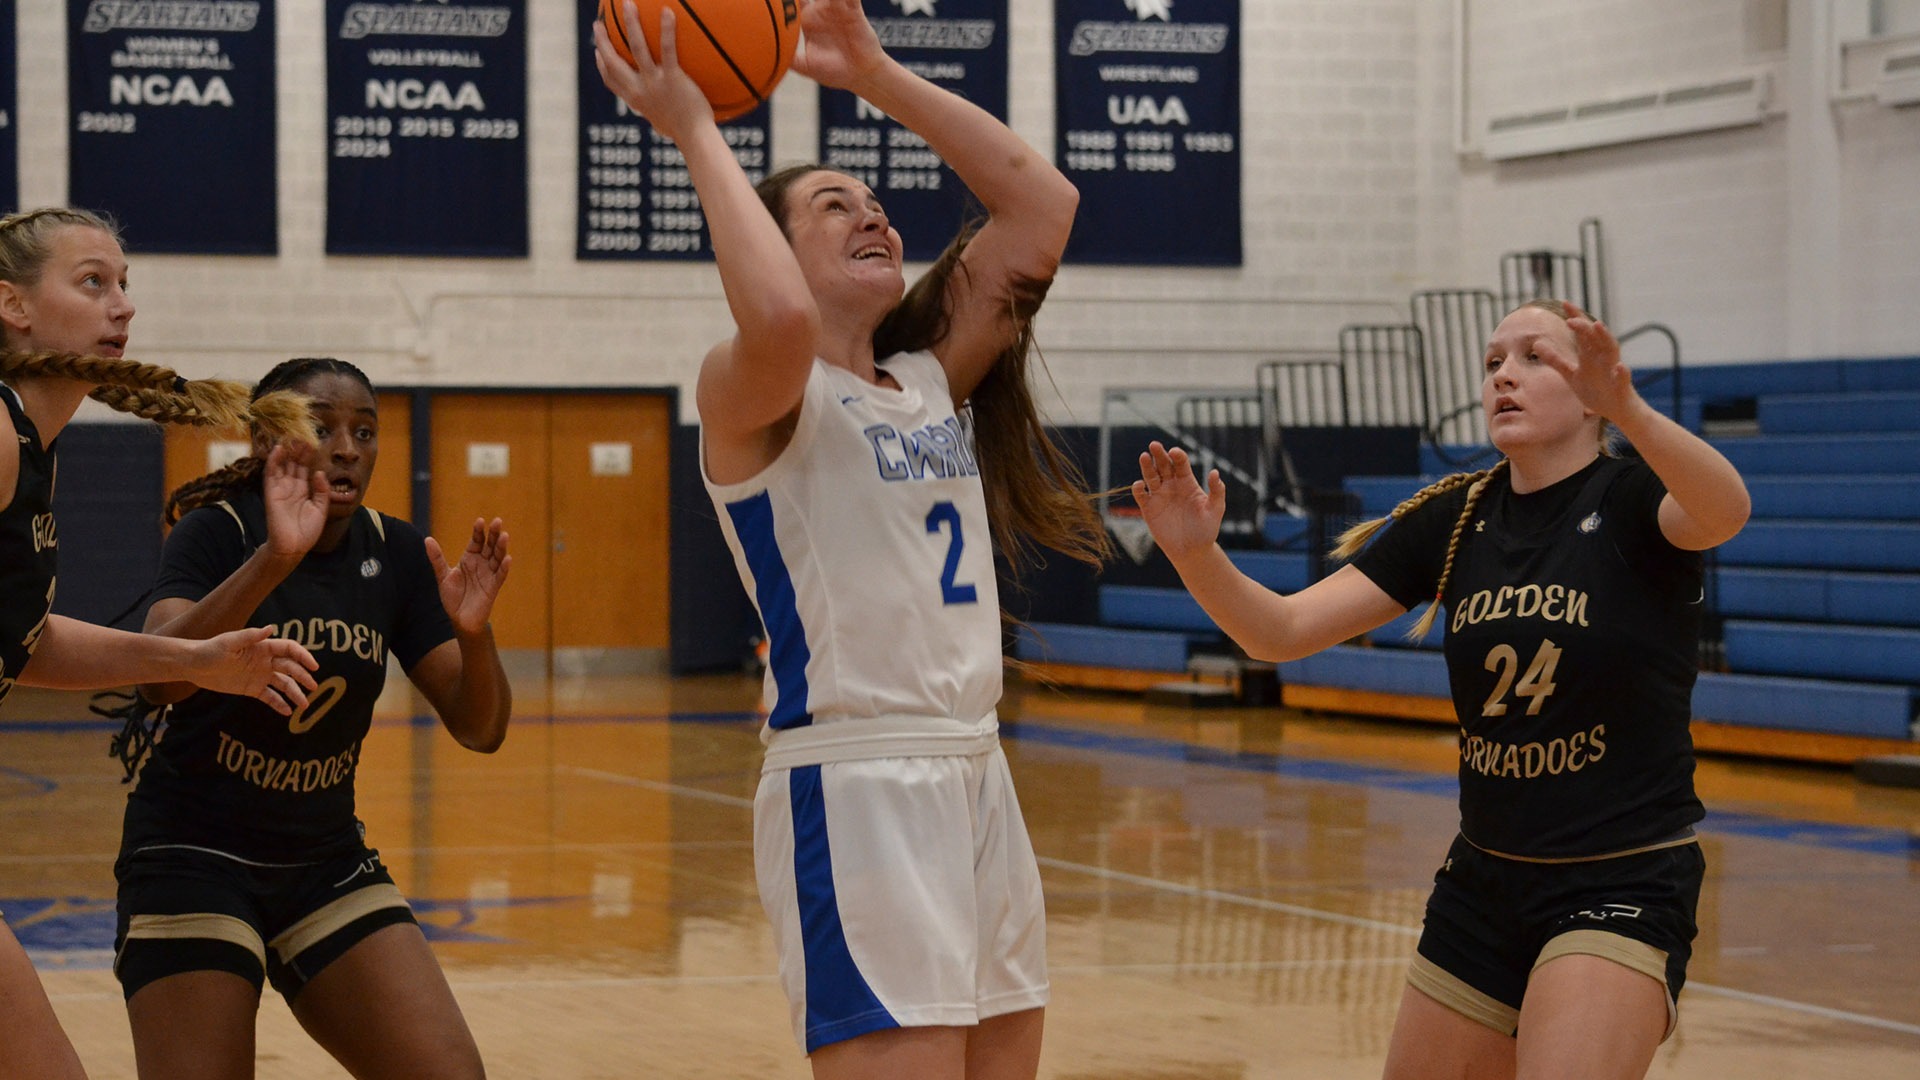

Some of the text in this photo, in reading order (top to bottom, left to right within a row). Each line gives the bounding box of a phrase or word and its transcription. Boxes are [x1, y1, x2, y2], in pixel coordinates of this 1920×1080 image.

[86, 1, 259, 32] SPARTANS
[340, 4, 511, 38] SPARTANS
[126, 37, 220, 54] WOMEN'S
[872, 18, 995, 49] ARTANS
[1070, 20, 1229, 55] SPARTANS
[111, 51, 235, 70] BASKETBALL
[367, 50, 484, 67] VOLLEYBALL
[1099, 66, 1199, 83] WRESTLING
[110, 74, 234, 107] NCAA
[365, 79, 485, 111] NCAA
[78, 112, 136, 133] 2002
[1107, 95, 1190, 125] UAA
[335, 116, 392, 136] 2010
[463, 118, 519, 139] 2023
[334, 138, 391, 157] 2024
[925, 501, 978, 606] 2
[1451, 584, 1589, 634] GOLDEN
[1481, 638, 1562, 717] 24
[288, 675, 347, 735] 0
[216, 731, 356, 793] TORNADOES
